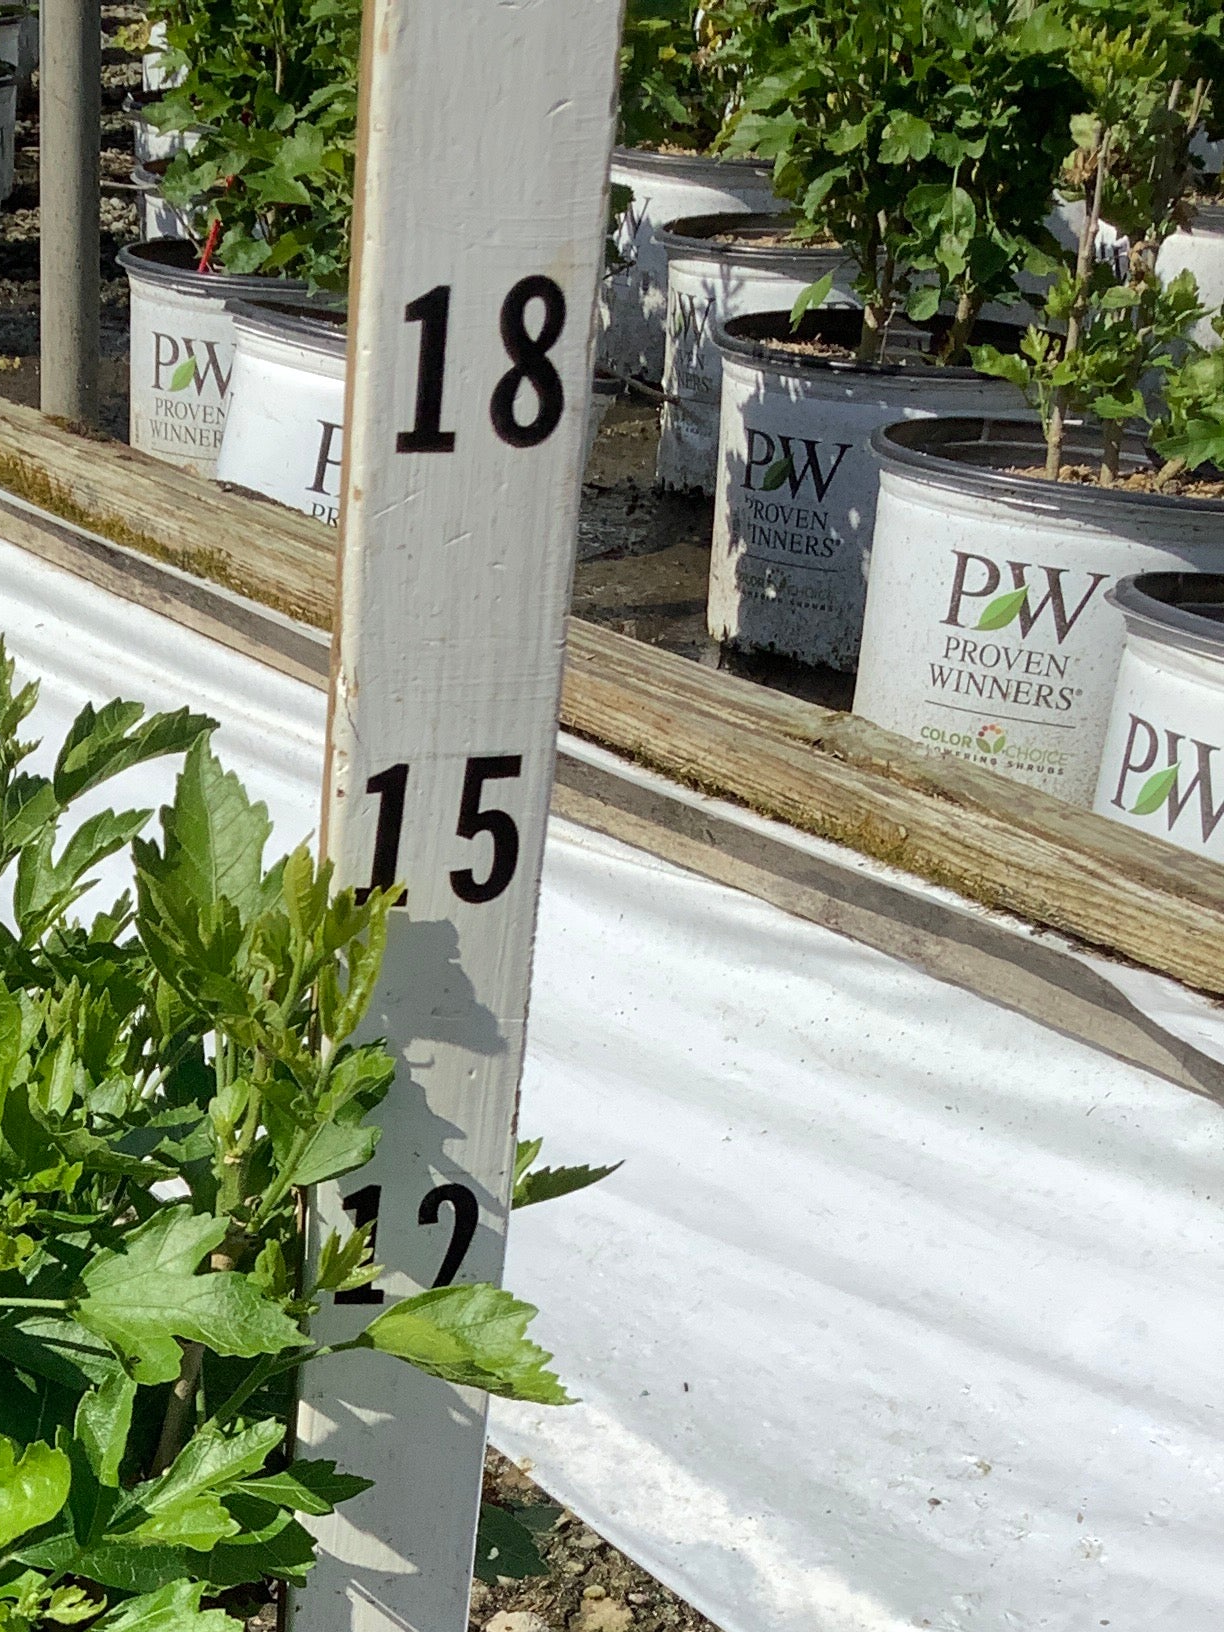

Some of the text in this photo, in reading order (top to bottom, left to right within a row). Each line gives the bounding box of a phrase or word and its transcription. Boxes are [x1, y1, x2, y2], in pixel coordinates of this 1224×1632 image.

[152, 331, 237, 400] PW
[396, 274, 567, 453] 18
[149, 418, 224, 448] WINNER
[740, 428, 853, 503] PW
[939, 550, 1110, 645] PW
[943, 635, 1071, 679] PROVEN
[920, 726, 1070, 766] COLOR CHOICE
[1007, 760, 1064, 776] SHRUBS
[354, 755, 523, 907] 15
[333, 1183, 479, 1305] 12
